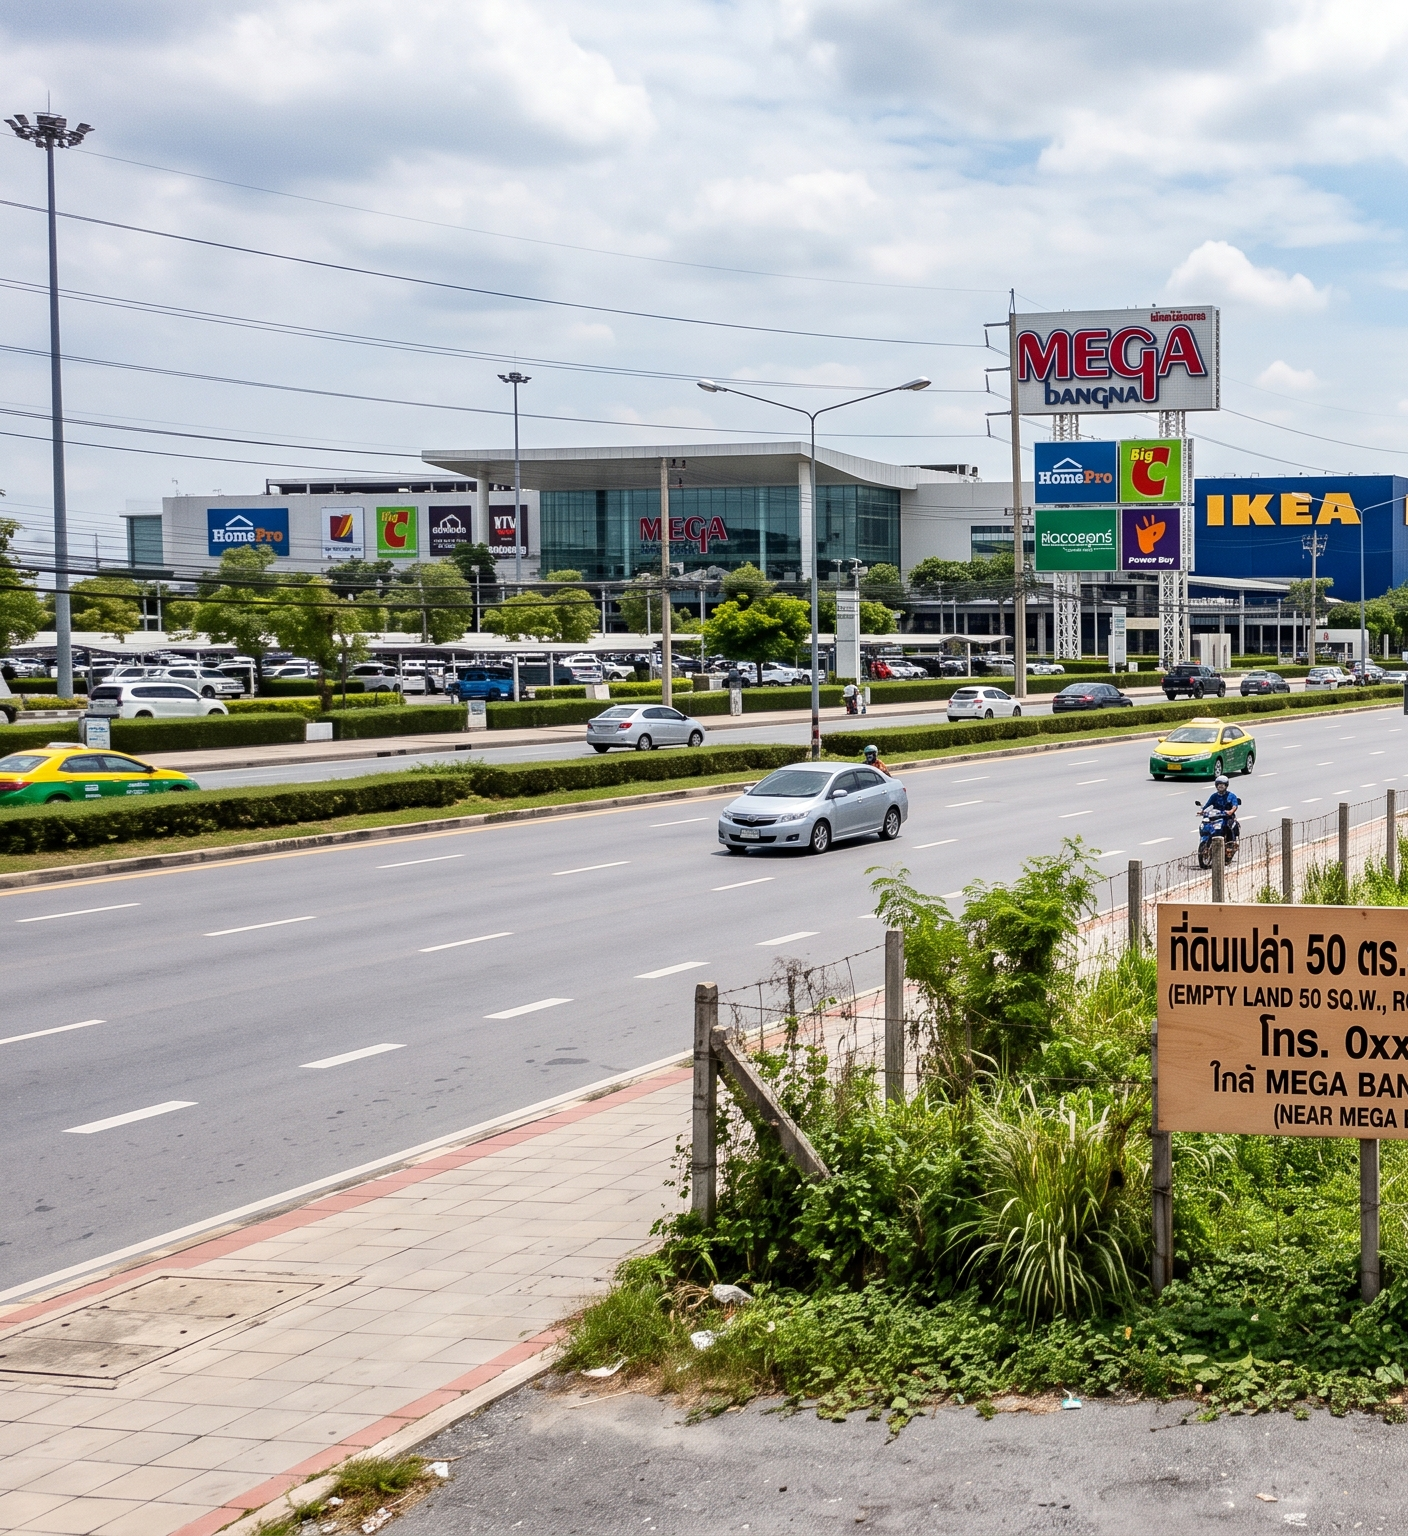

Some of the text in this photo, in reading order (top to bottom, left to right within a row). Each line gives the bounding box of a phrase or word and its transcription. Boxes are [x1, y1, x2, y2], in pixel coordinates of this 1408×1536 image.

[1016, 324, 1208, 403] MEGA
[1130, 448, 1154, 464] Big
[1131, 446, 1171, 498] C
[1038, 470, 1113, 485] HomePro
[1206, 492, 1362, 527] IKEA
[212, 528, 284, 543] HomePro
[639, 515, 729, 554] MEGA
[1128, 556, 1157, 564] Power
[1170, 910, 1294, 975] ที่ดินเปล่า
[1306, 933, 1346, 976] 50
[1168, 983, 1238, 1009] (EMPTY
[1243, 986, 1293, 1008] LAND
[1299, 988, 1322, 1009] 50
[1327, 989, 1387, 1015] SQ.W.,
[1259, 1013, 1329, 1058] โทร.
[1210, 1060, 1256, 1093] ใกล้
[1266, 1069, 1348, 1096] MEGA
[1273, 1103, 1333, 1129] (NEAR
[1339, 1106, 1397, 1128] MEGA
